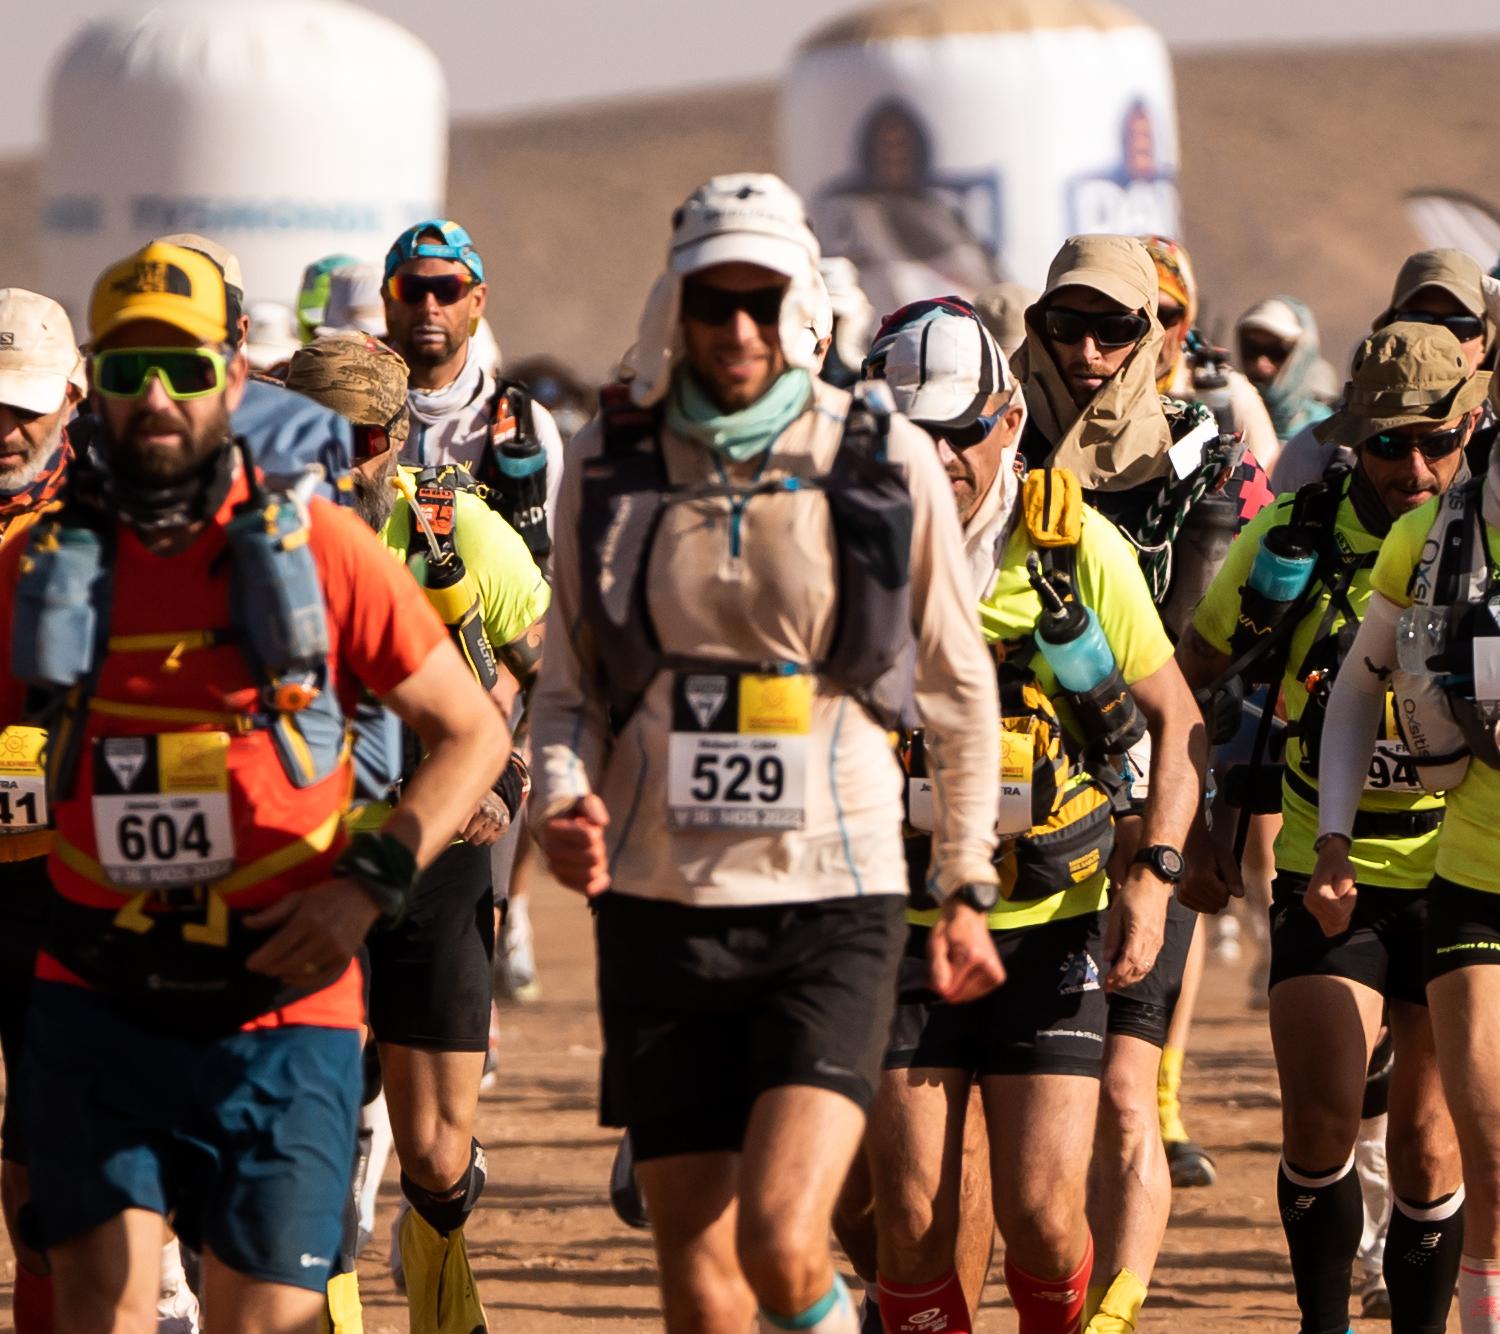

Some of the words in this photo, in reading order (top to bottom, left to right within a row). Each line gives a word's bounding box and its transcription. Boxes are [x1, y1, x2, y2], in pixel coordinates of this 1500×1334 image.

[1414, 538, 1441, 607] Oxsi
[476, 637, 497, 678] ULTRA
[691, 753, 784, 803] 529
[1368, 755, 1418, 788] 94
[118, 812, 212, 861] 604
